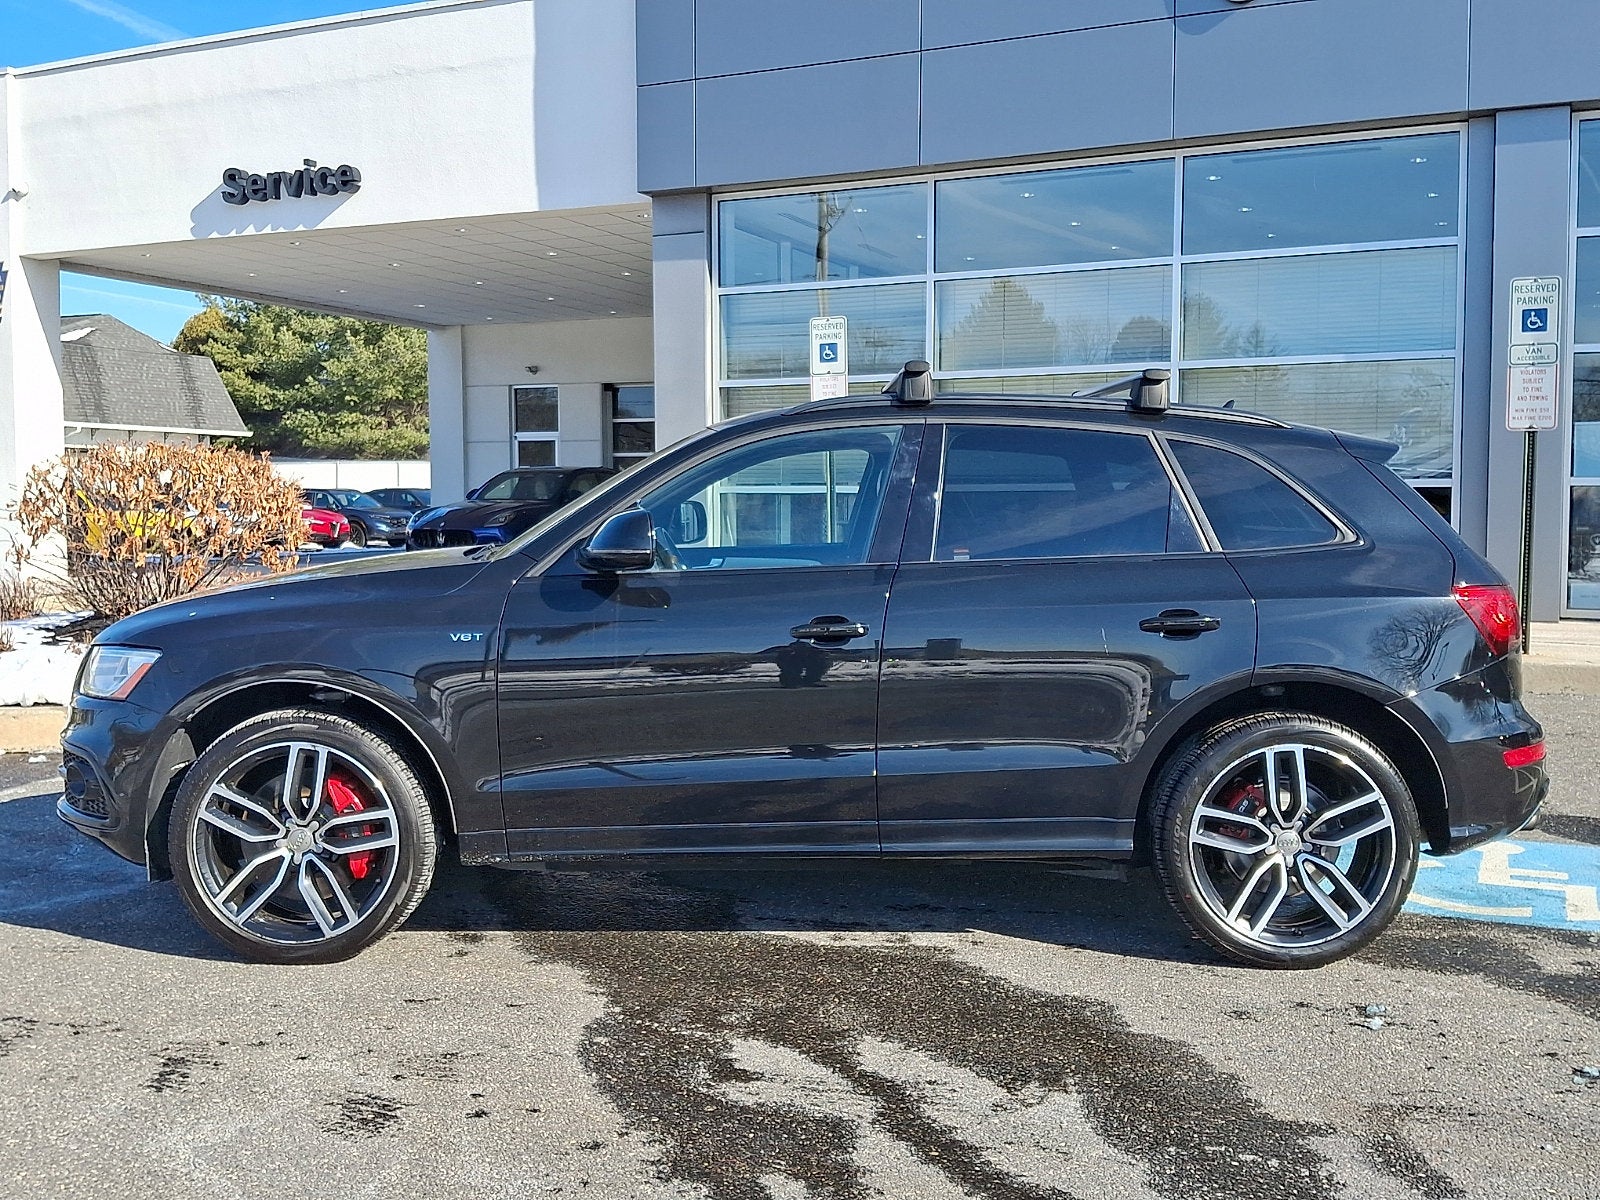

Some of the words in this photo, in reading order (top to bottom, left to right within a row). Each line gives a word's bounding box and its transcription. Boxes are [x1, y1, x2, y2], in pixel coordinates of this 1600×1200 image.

[221, 158, 361, 205] Service
[1514, 283, 1557, 294] RESERVED
[1516, 295, 1554, 305] PARKING
[813, 322, 843, 331] RESERVED
[1525, 347, 1543, 355] VAN
[449, 633, 483, 642] V6T
